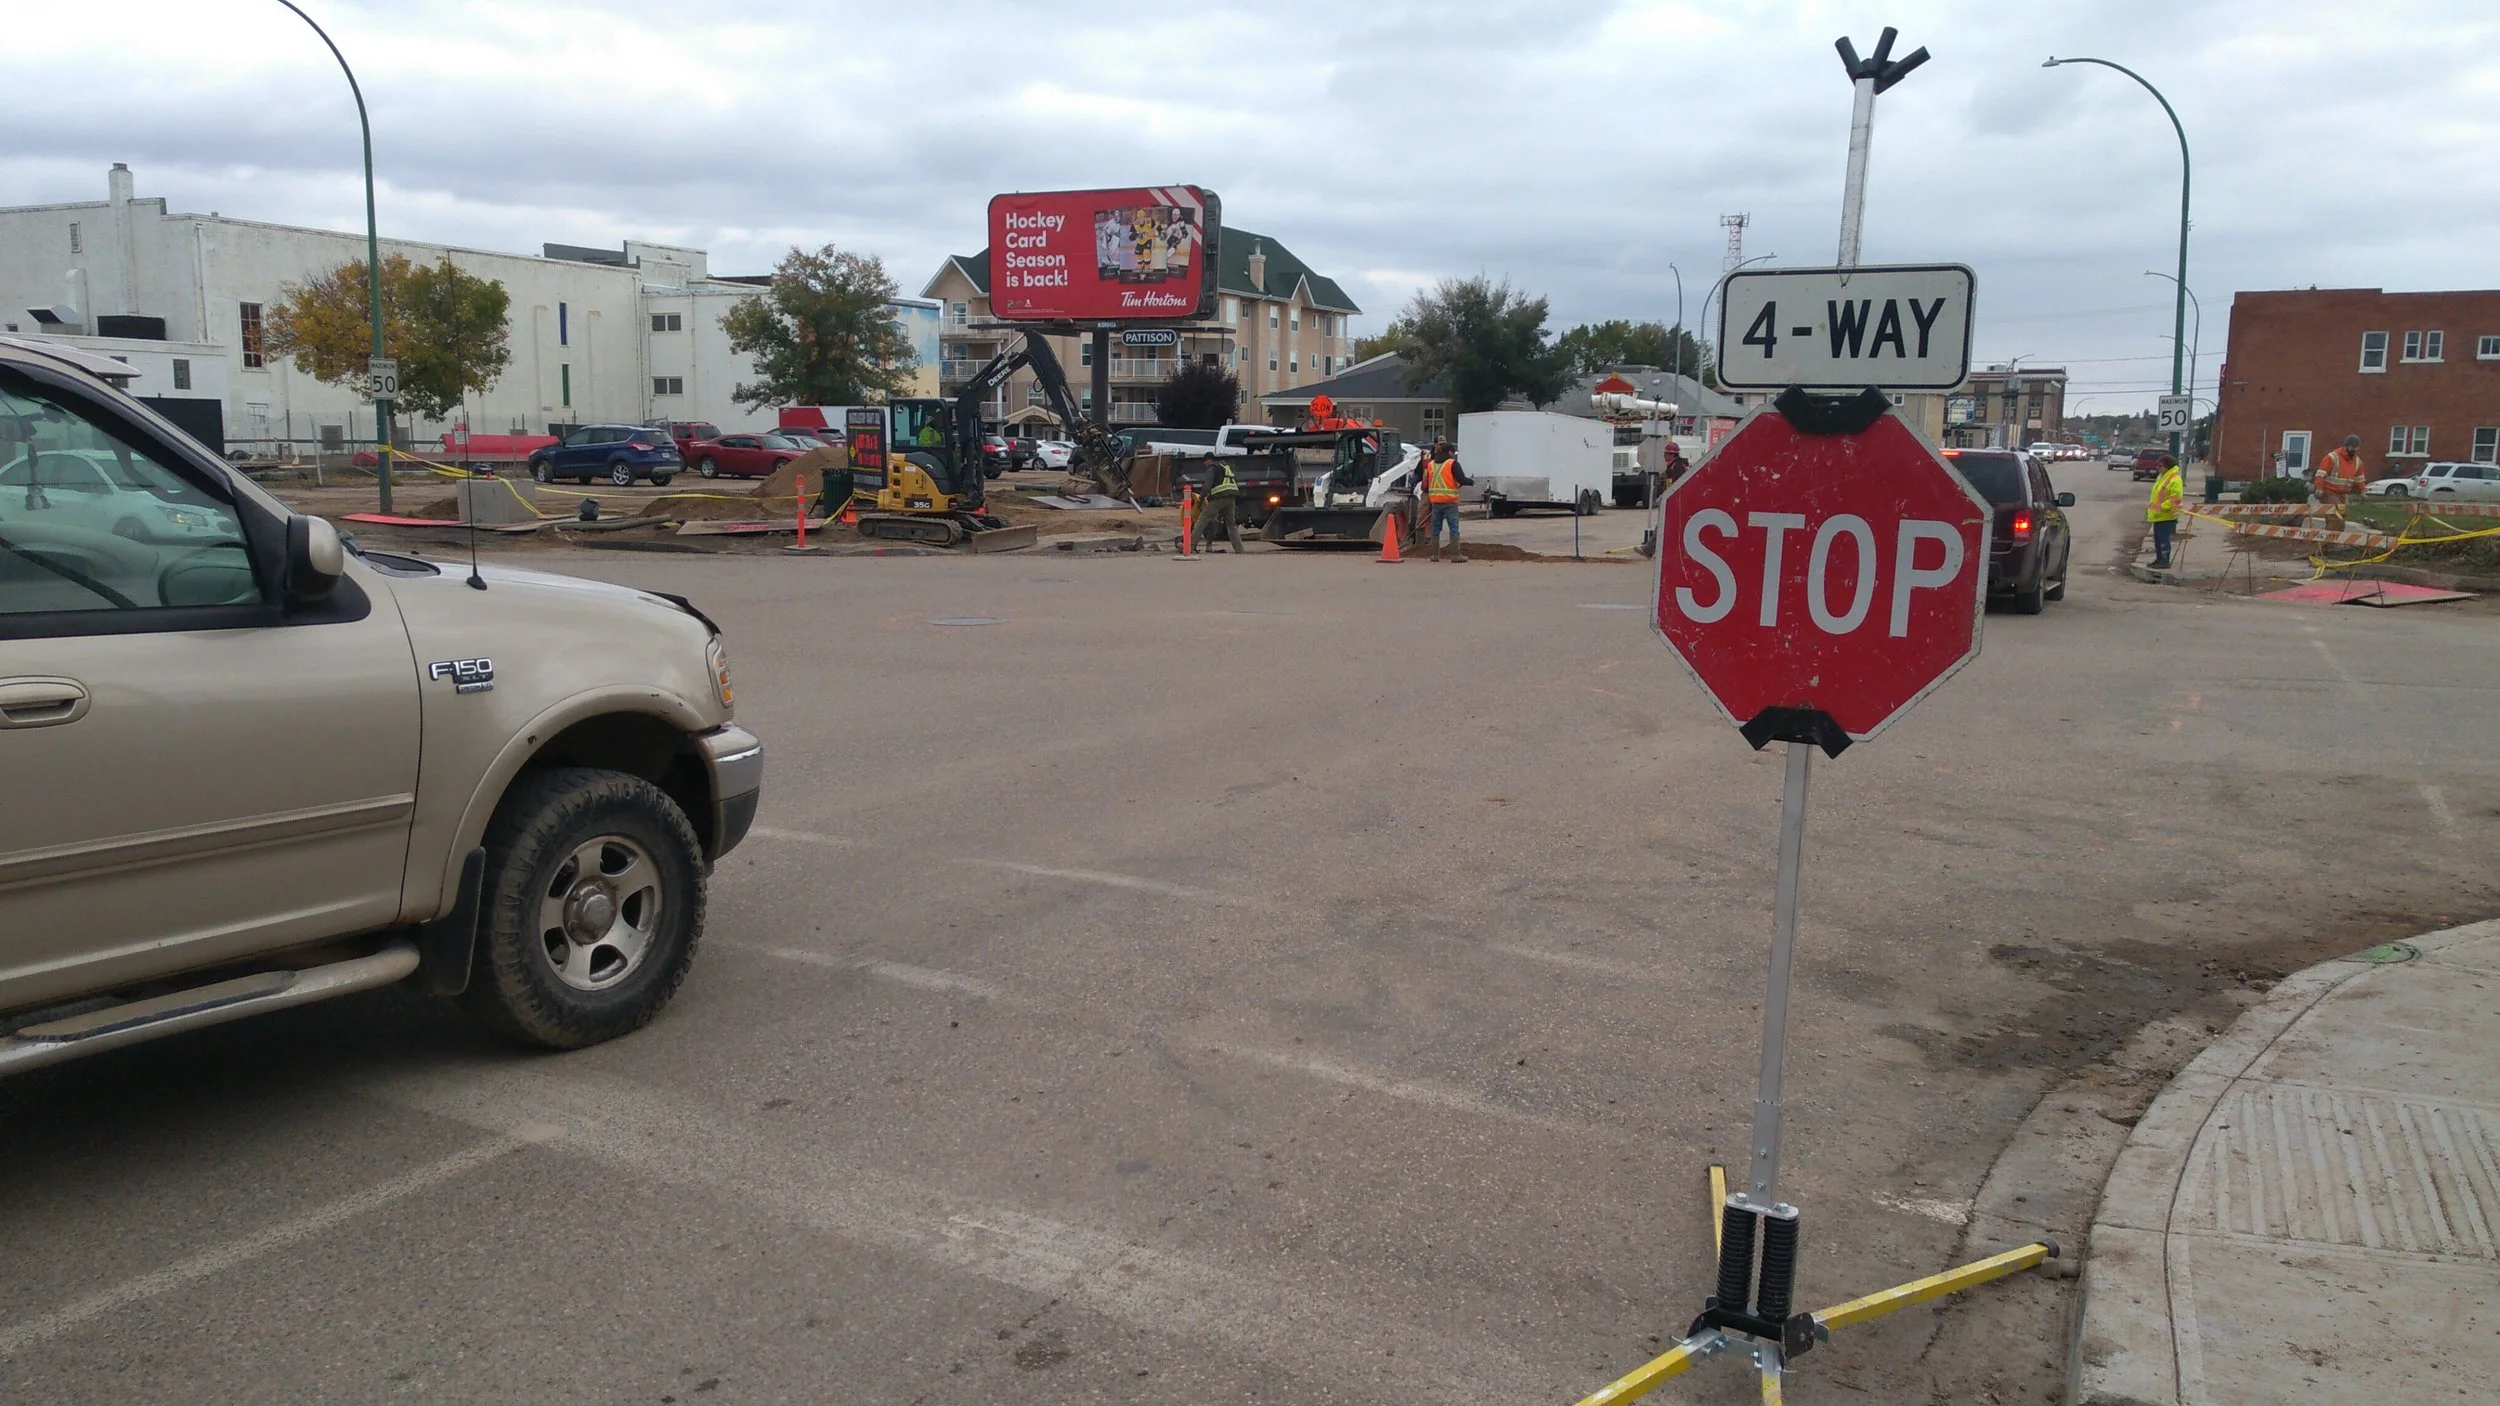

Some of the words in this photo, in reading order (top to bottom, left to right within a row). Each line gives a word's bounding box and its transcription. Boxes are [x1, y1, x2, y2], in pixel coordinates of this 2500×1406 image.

[1005, 211, 1065, 232] Hockey
[1005, 230, 1047, 248] Card
[1005, 252, 1066, 268] Season
[1006, 271, 1019, 287] is
[1023, 269, 1068, 287] back!
[1121, 291, 1141, 307] Tim
[1142, 290, 1187, 307] Hortons
[1125, 332, 1172, 343] PATTISON
[373, 375, 396, 393] 50
[987, 365, 1012, 387] DEERE
[1311, 403, 1330, 412] SLOW
[2160, 409, 2187, 426] 50
[913, 501, 930, 509] 35G
[1675, 508, 1965, 637] STOP
[462, 673, 489, 681] XLT
